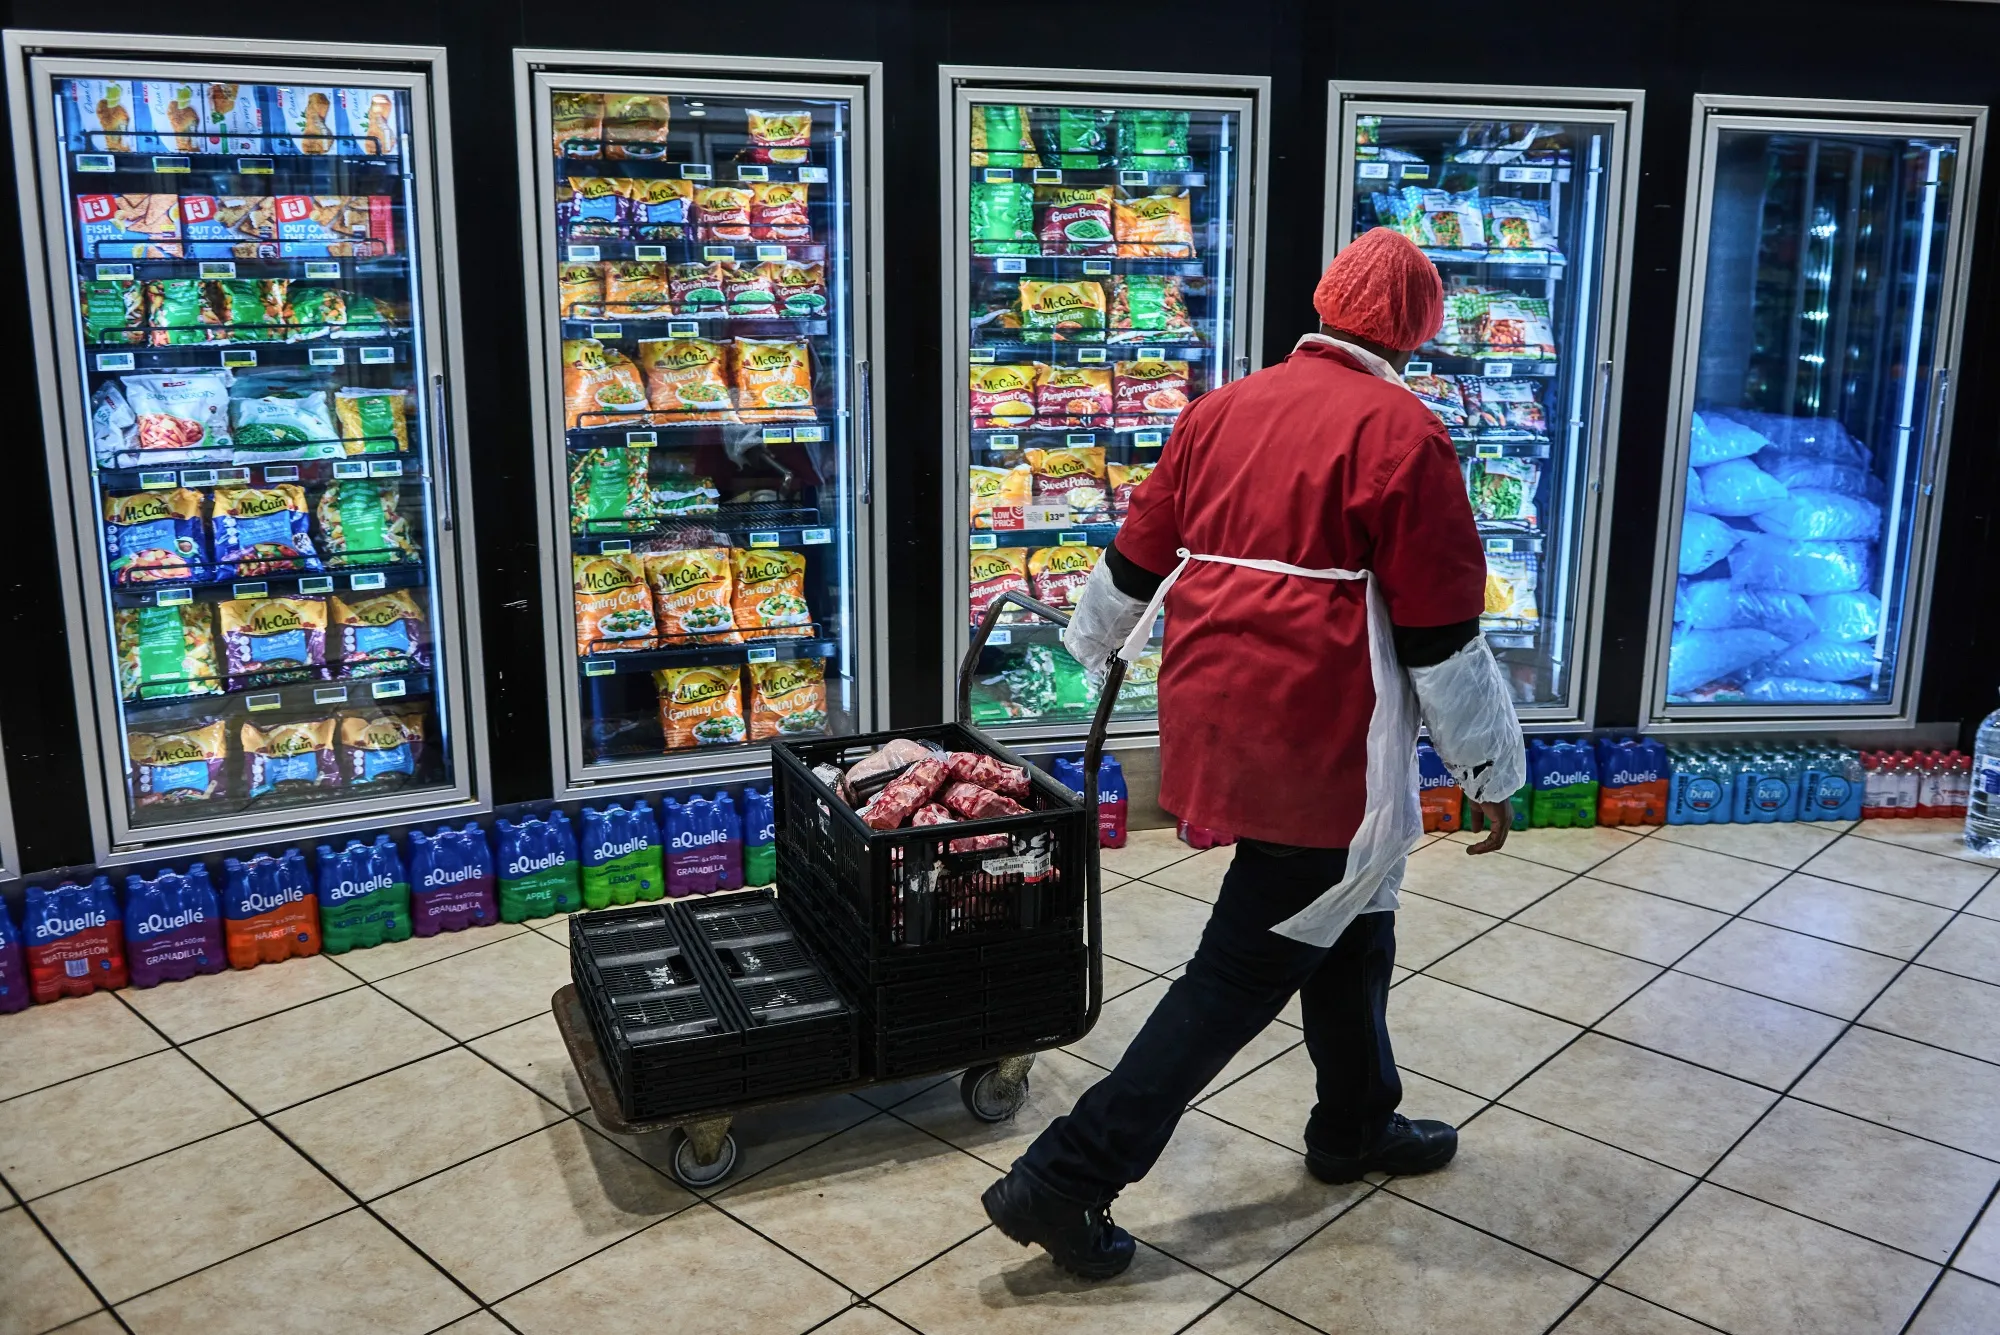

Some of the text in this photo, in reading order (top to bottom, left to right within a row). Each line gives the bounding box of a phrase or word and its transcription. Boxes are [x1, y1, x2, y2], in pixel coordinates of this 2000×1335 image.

[766, 126, 795, 137] McCain
[584, 184, 614, 195] McCain
[649, 188, 678, 201] McCain
[1057, 189, 1096, 205] McCain
[83, 198, 111, 220] I&J
[184, 199, 210, 221] I&J
[281, 199, 306, 220] I&J
[1052, 207, 1106, 222] Green Beans
[86, 225, 112, 234] FISH
[188, 225, 210, 234] OUT
[283, 225, 305, 233] OUT
[681, 282, 702, 291] Green
[732, 283, 754, 292] Green
[781, 286, 802, 295] Green
[1043, 291, 1083, 310] McCain
[1038, 311, 1085, 325] Baby Carrots
[666, 351, 709, 366] McCain
[753, 354, 791, 366] McCain
[663, 369, 695, 383] Mixed
[1056, 375, 1084, 385] McCain
[1134, 367, 1172, 378] McCain
[983, 378, 1023, 391] McCain
[1120, 382, 1152, 398] Carrots
[1043, 389, 1074, 402] Pumpkin
[1049, 464, 1085, 476] McCain
[1039, 476, 1096, 491] Sweet Potato
[124, 502, 171, 521] McCain
[241, 498, 287, 515] McCain
[993, 511, 1010, 520] LOW
[994, 519, 1016, 527] PRICE
[746, 562, 790, 580] McCain
[973, 562, 1012, 578] McCain
[1051, 556, 1088, 571] McCain
[584, 572, 633, 589] McCain
[662, 568, 710, 588] McCain
[777, 580, 799, 591] Mix
[574, 591, 647, 614] Country Crop
[254, 614, 301, 631] McCain
[679, 684, 727, 699] McCain
[761, 676, 805, 693] McCain
[669, 705, 711, 721] Country
[754, 700, 793, 714] Country
[156, 748, 204, 761] McCain
[1543, 771, 1590, 786] aQuellé
[1613, 769, 1657, 783] aQuellé
[671, 829, 727, 849] aQuellé
[593, 835, 648, 861] aQuellé
[509, 851, 566, 874] aQuellé
[424, 864, 483, 887] aQuellé
[676, 864, 725, 877] GRANADILLA
[331, 872, 393, 900] aQuellé
[608, 873, 637, 886] LEMON
[241, 886, 304, 912] aQuellé
[525, 889, 552, 902] APPLE
[428, 901, 481, 917] GRANADILLA
[36, 909, 106, 938] aQuellé
[138, 907, 205, 935] aQuellé
[255, 925, 297, 941] NAARTJIE
[42, 946, 109, 965] WATERMELON
[146, 947, 205, 966] GRANADILLA
